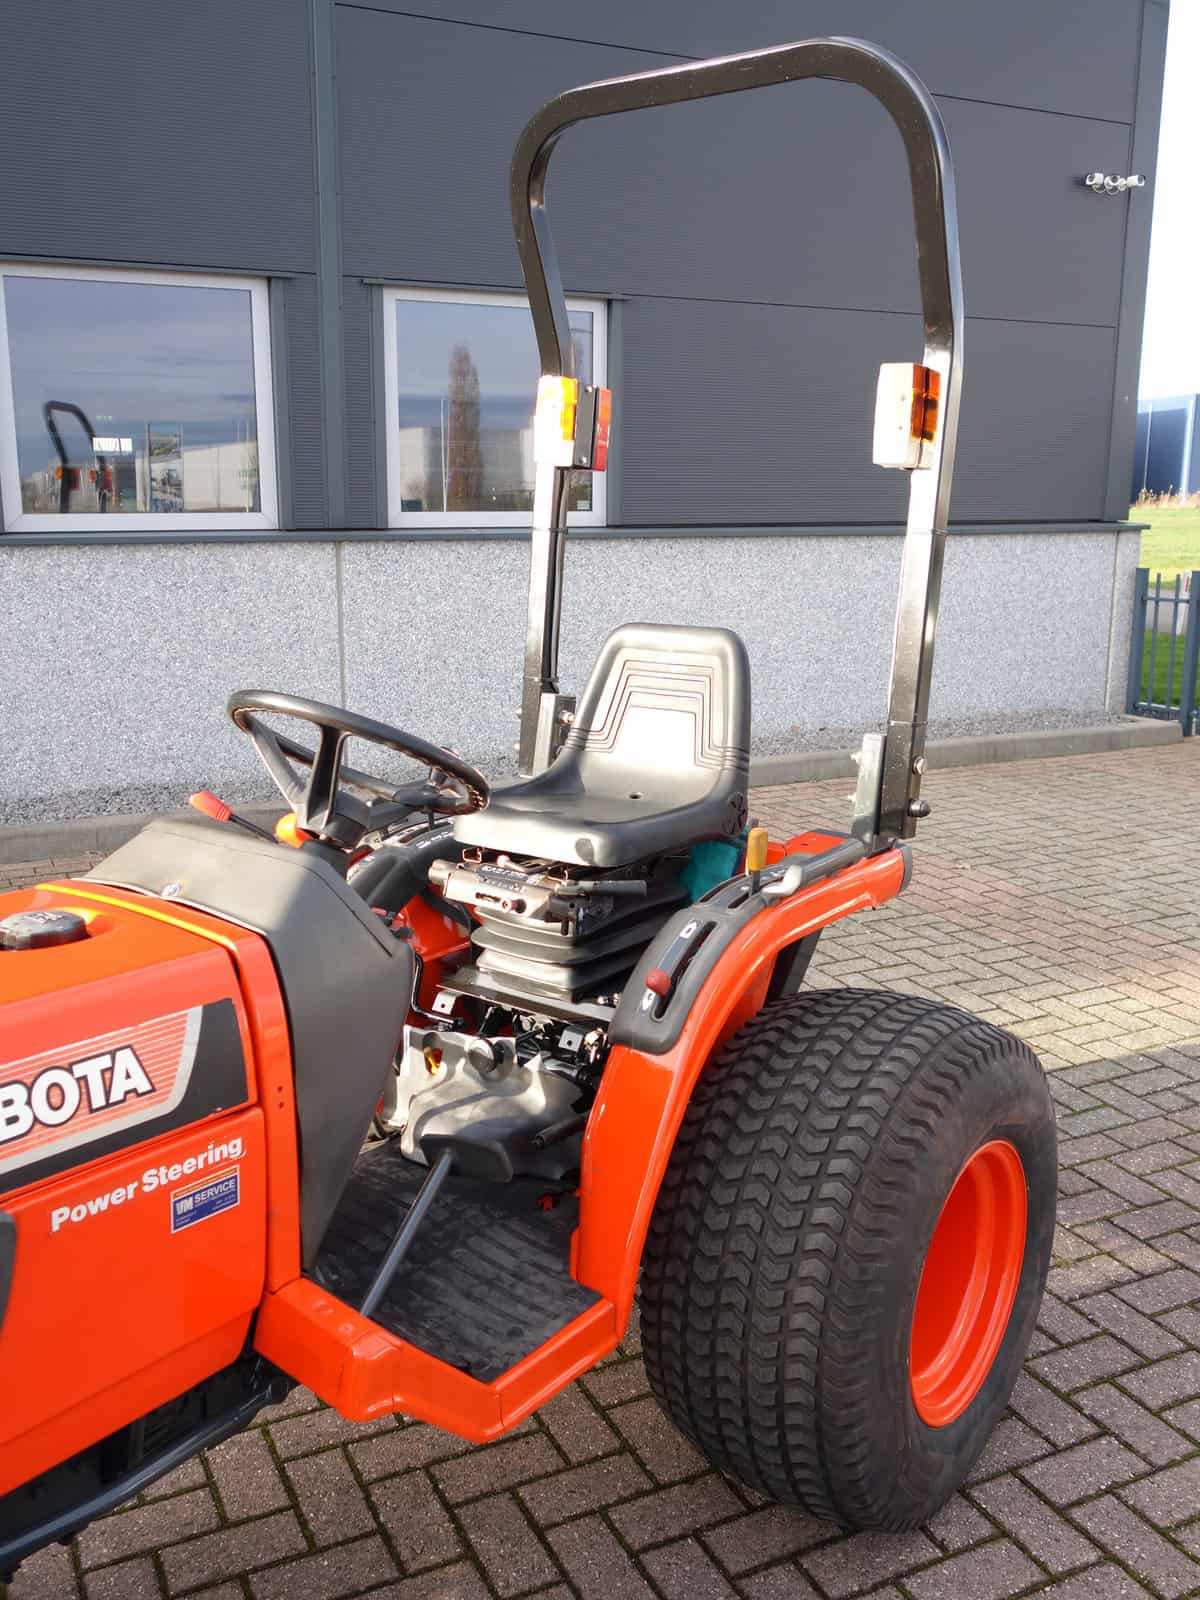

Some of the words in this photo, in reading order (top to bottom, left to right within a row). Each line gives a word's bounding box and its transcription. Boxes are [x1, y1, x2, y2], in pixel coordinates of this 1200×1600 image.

[0, 1044, 156, 1145] BOTA
[50, 1180, 138, 1233] Power
[141, 1136, 243, 1193] Steering
[194, 1178, 236, 1206] SERVICE
